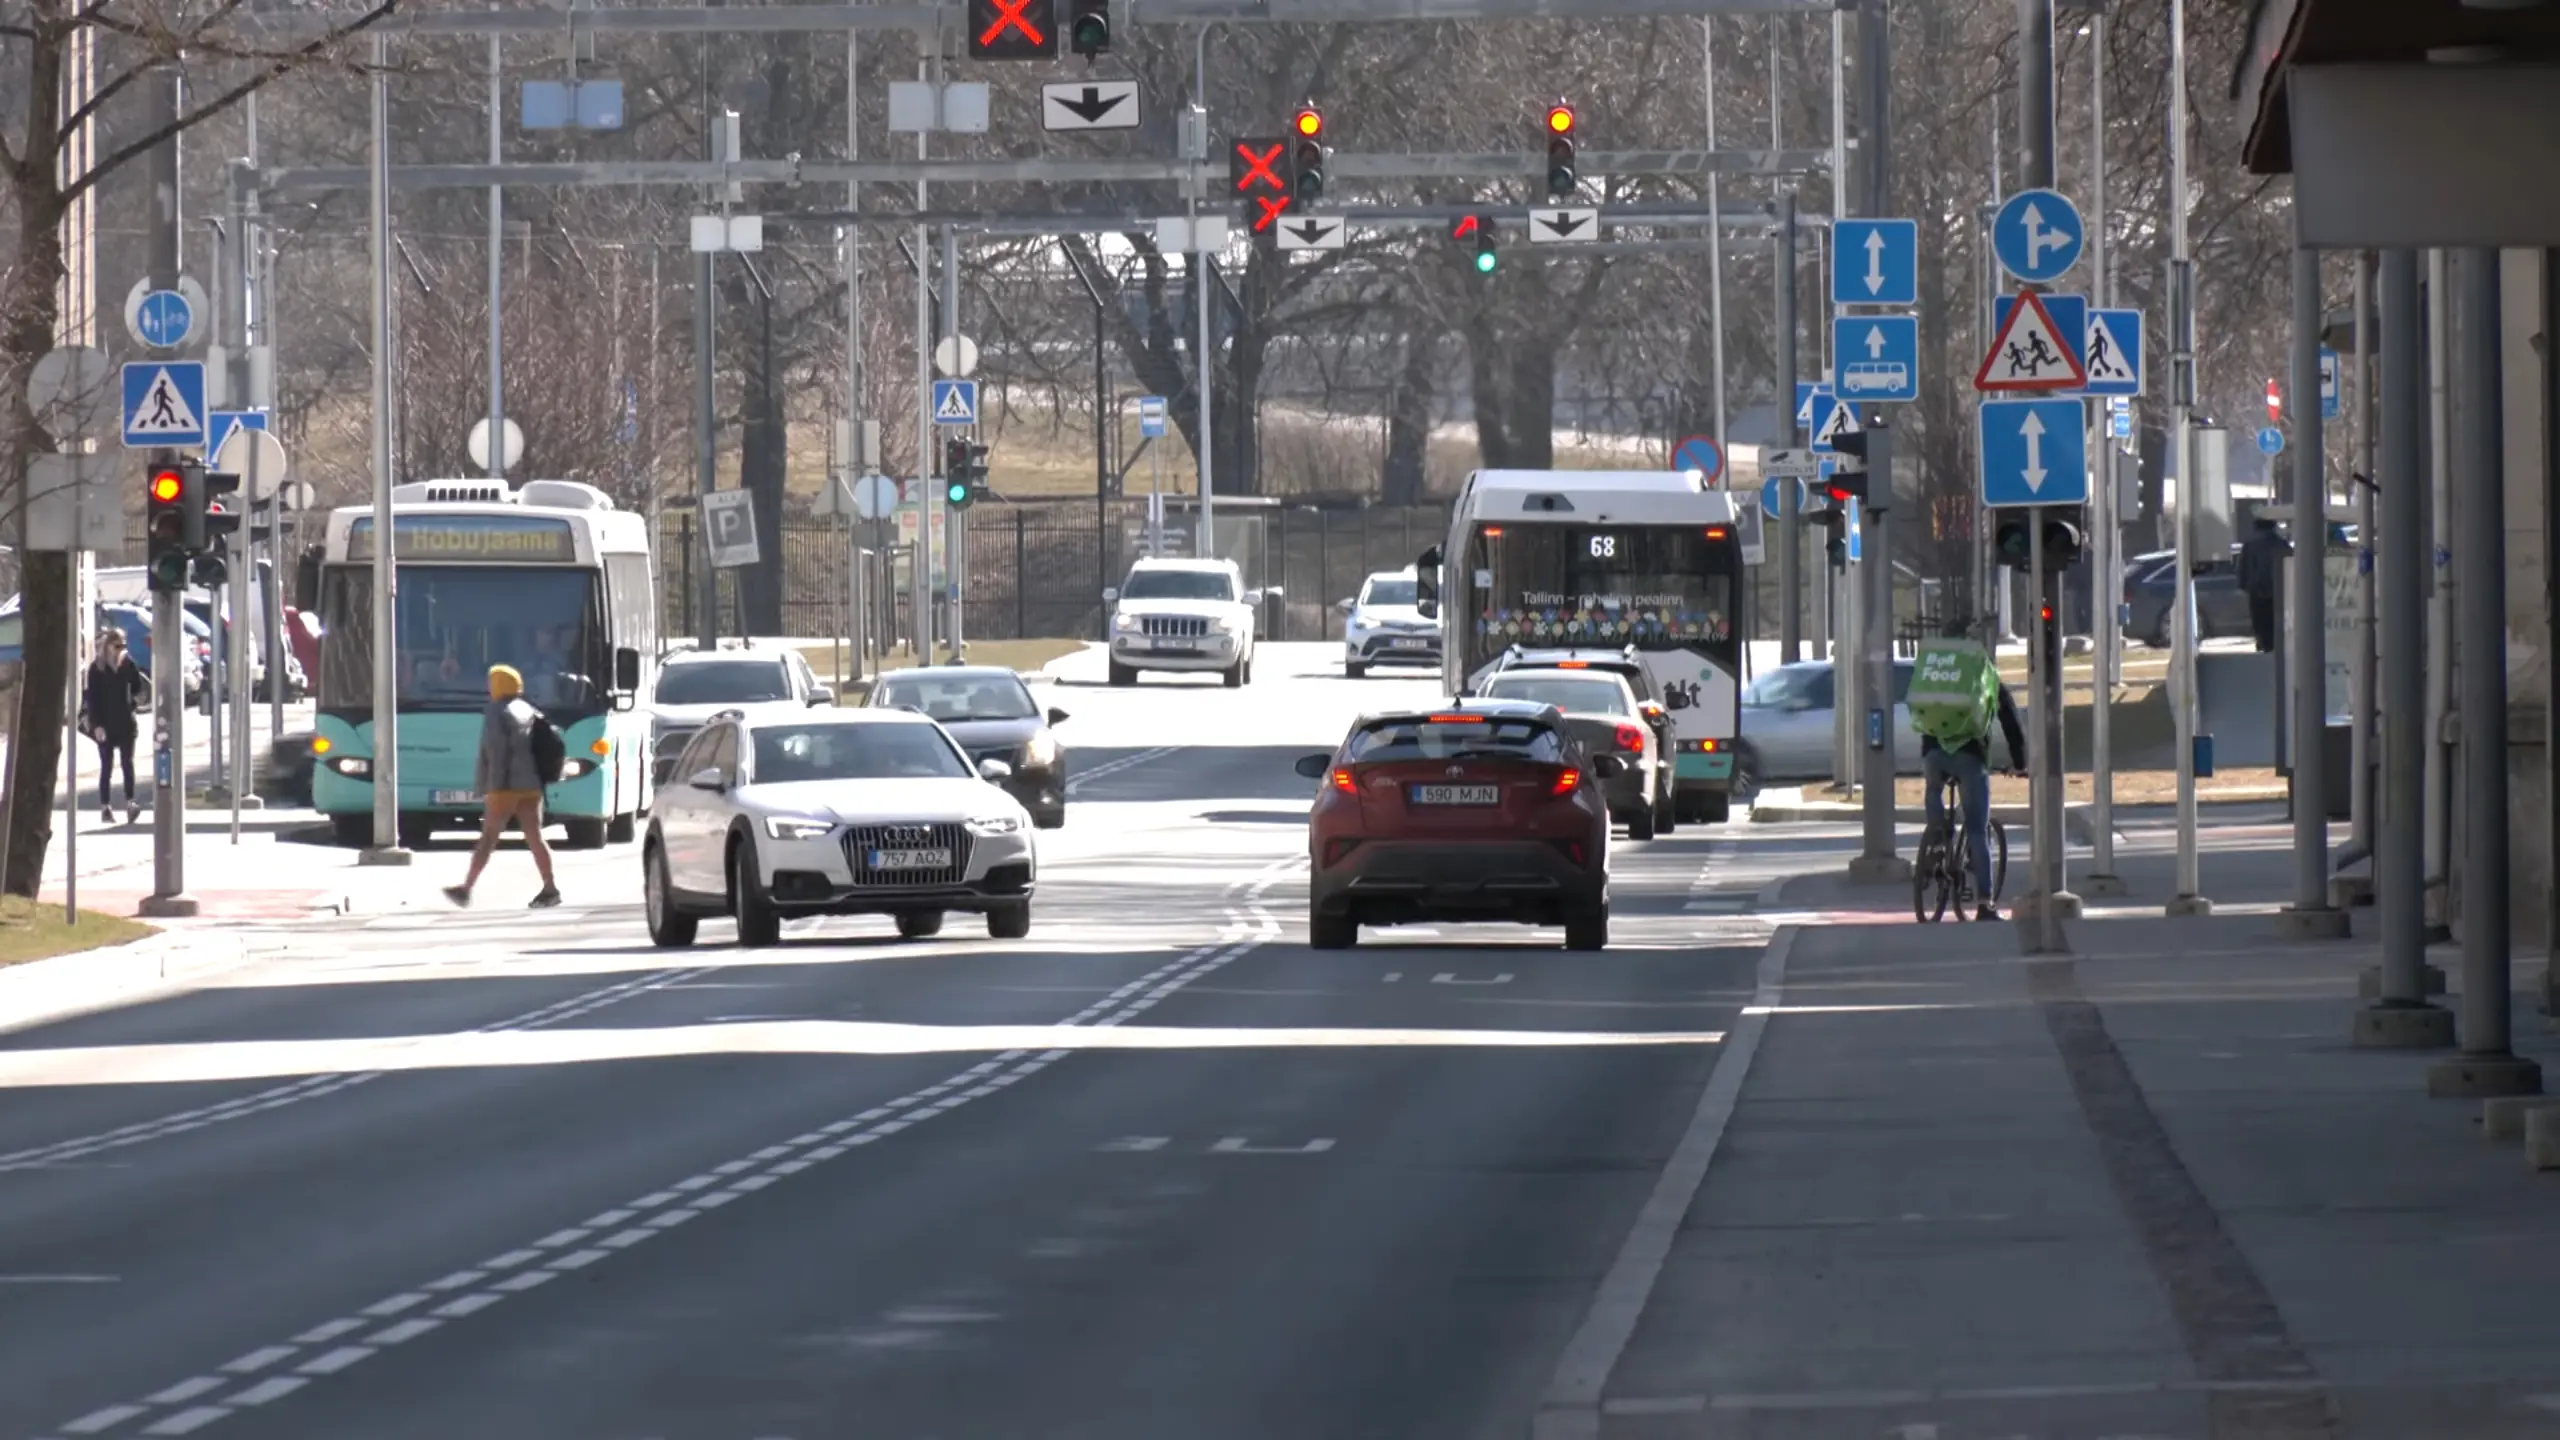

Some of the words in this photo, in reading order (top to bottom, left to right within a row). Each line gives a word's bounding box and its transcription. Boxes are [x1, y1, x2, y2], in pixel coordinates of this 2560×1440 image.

[1591, 535, 1615, 558] 68
[1522, 591, 1565, 605] Tallinn
[1635, 592, 1684, 608] pealinn
[1922, 666, 1961, 682] Food
[1426, 788, 1451, 801] 590
[1459, 788, 1493, 801] MJN
[883, 851, 908, 866] 757
